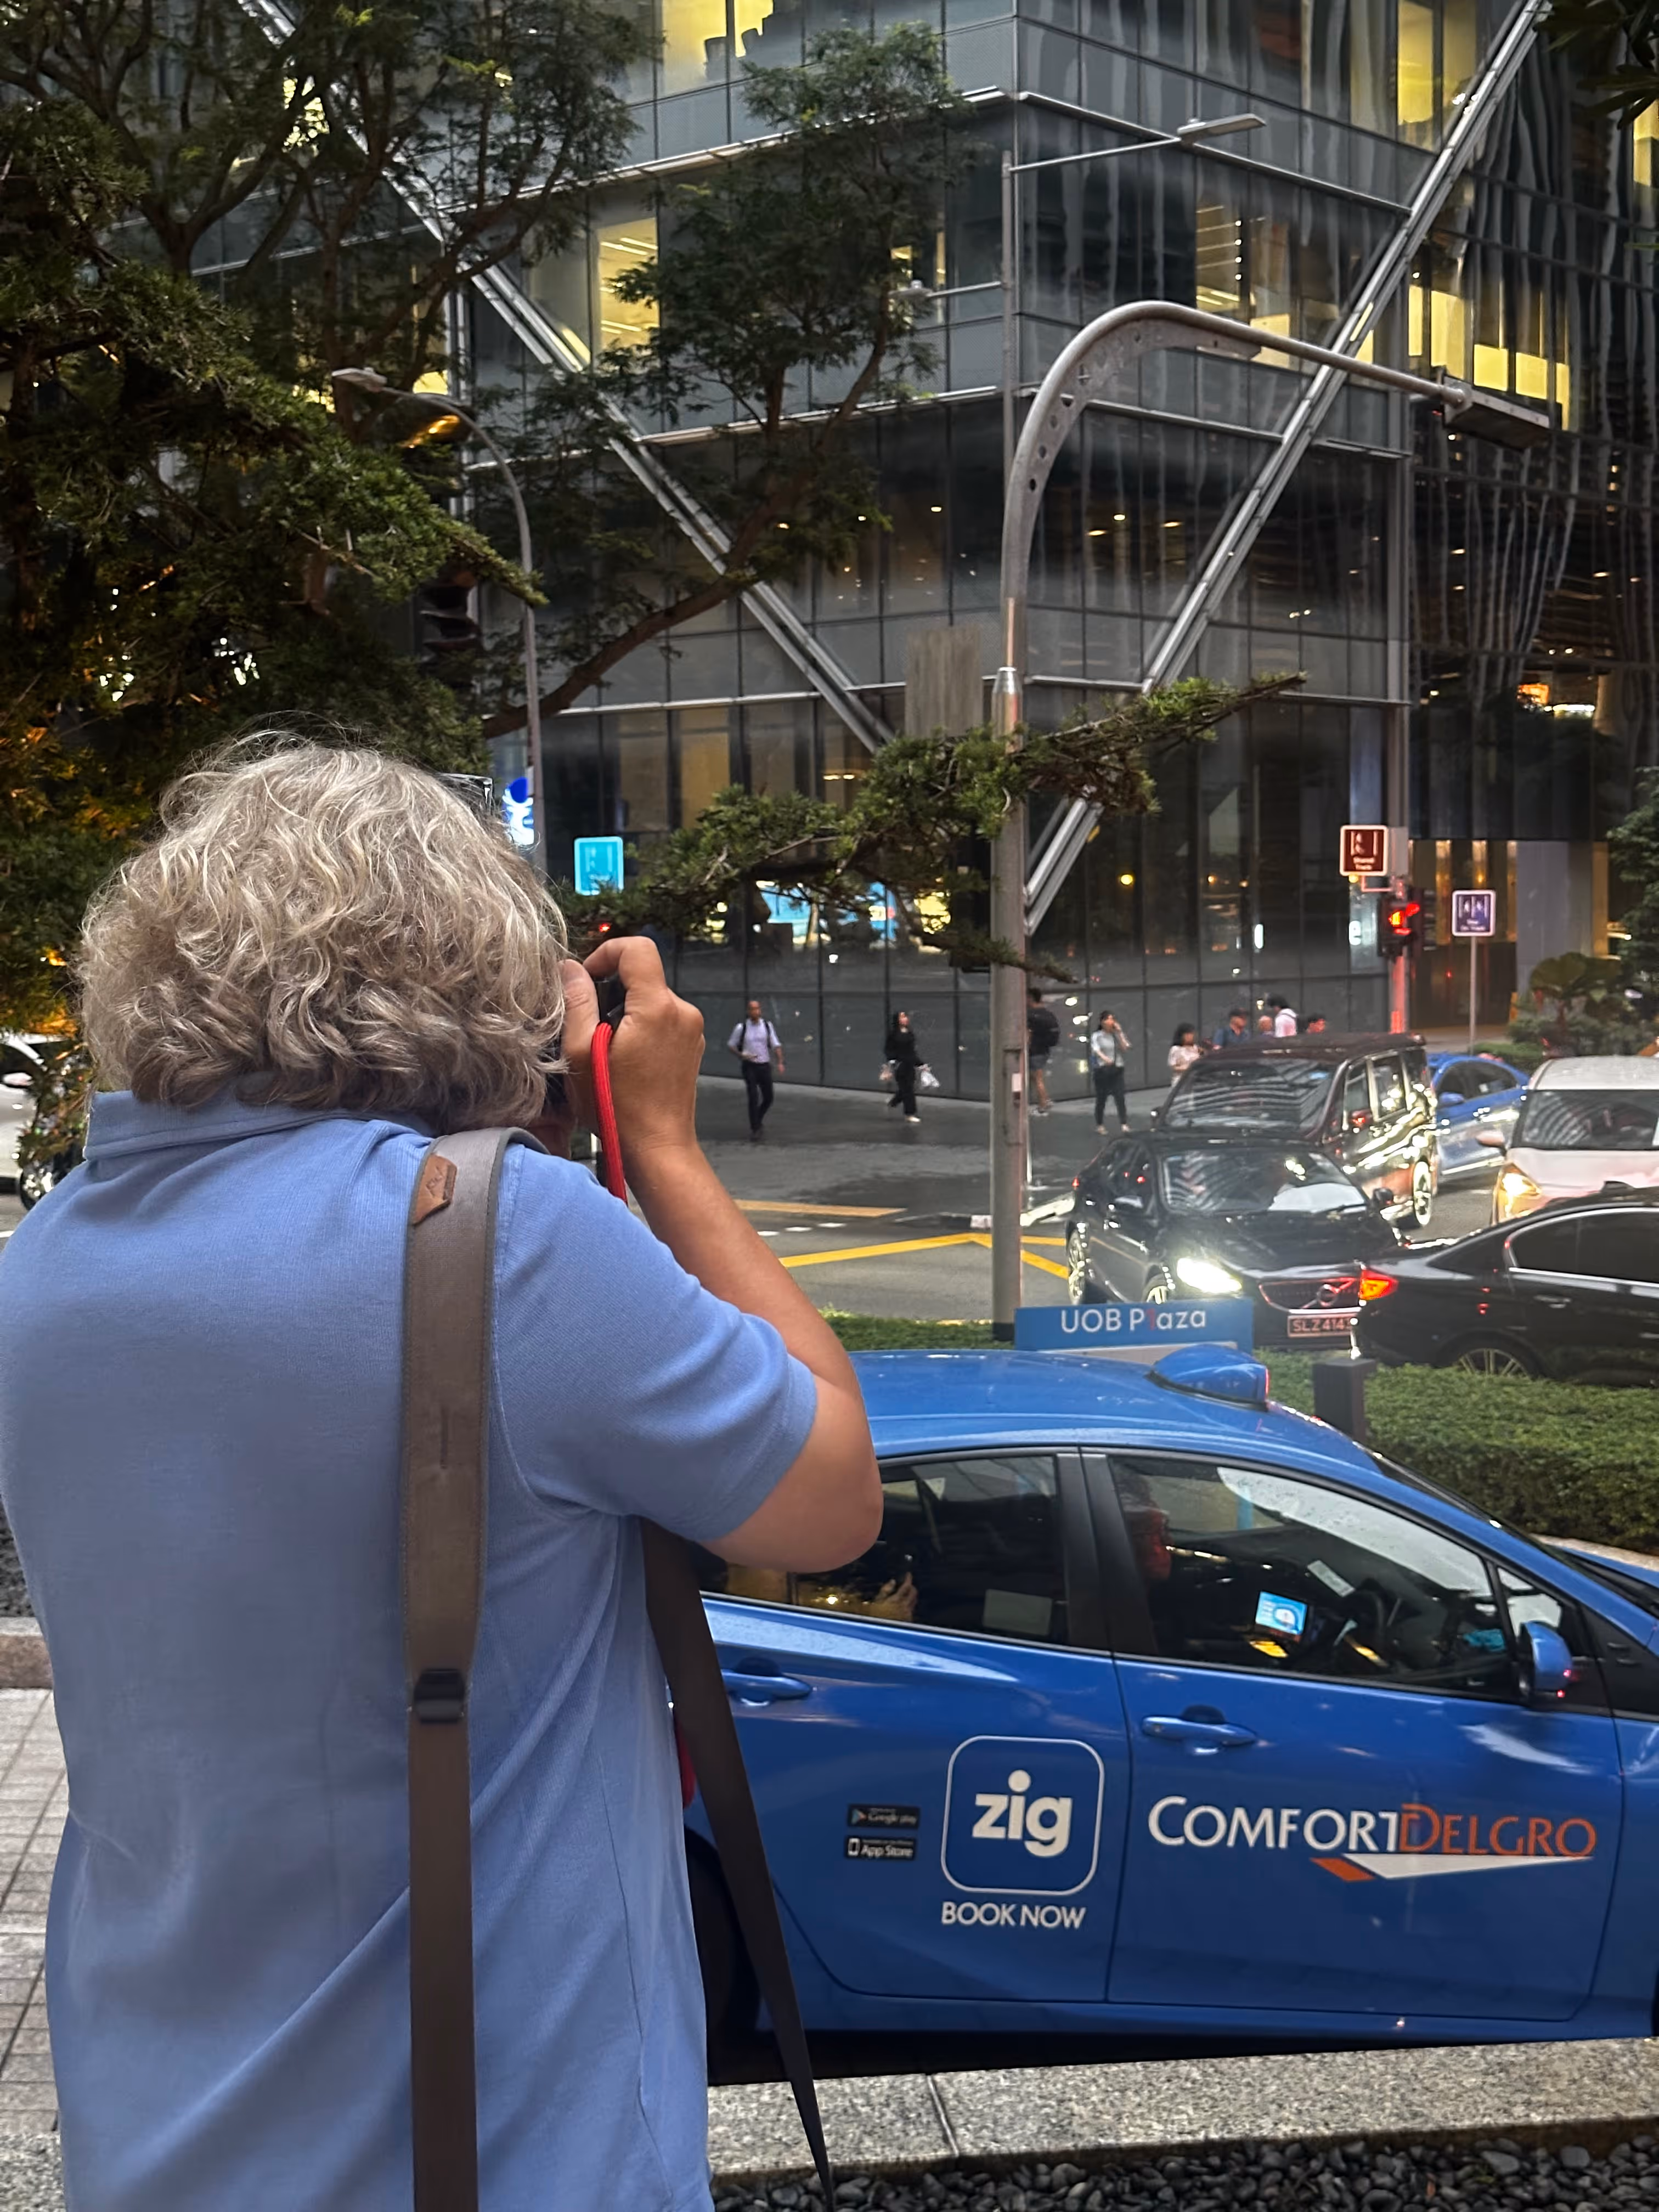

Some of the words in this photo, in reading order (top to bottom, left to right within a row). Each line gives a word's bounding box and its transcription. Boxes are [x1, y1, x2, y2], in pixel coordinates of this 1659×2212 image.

[1060, 1308, 1122, 1333] UOB
[972, 1769, 1073, 1858] zig
[860, 1844, 885, 1859] App
[884, 1845, 913, 1858] Store
[941, 1901, 1017, 1927] BOOK
[1019, 1904, 1086, 1929] NOW
